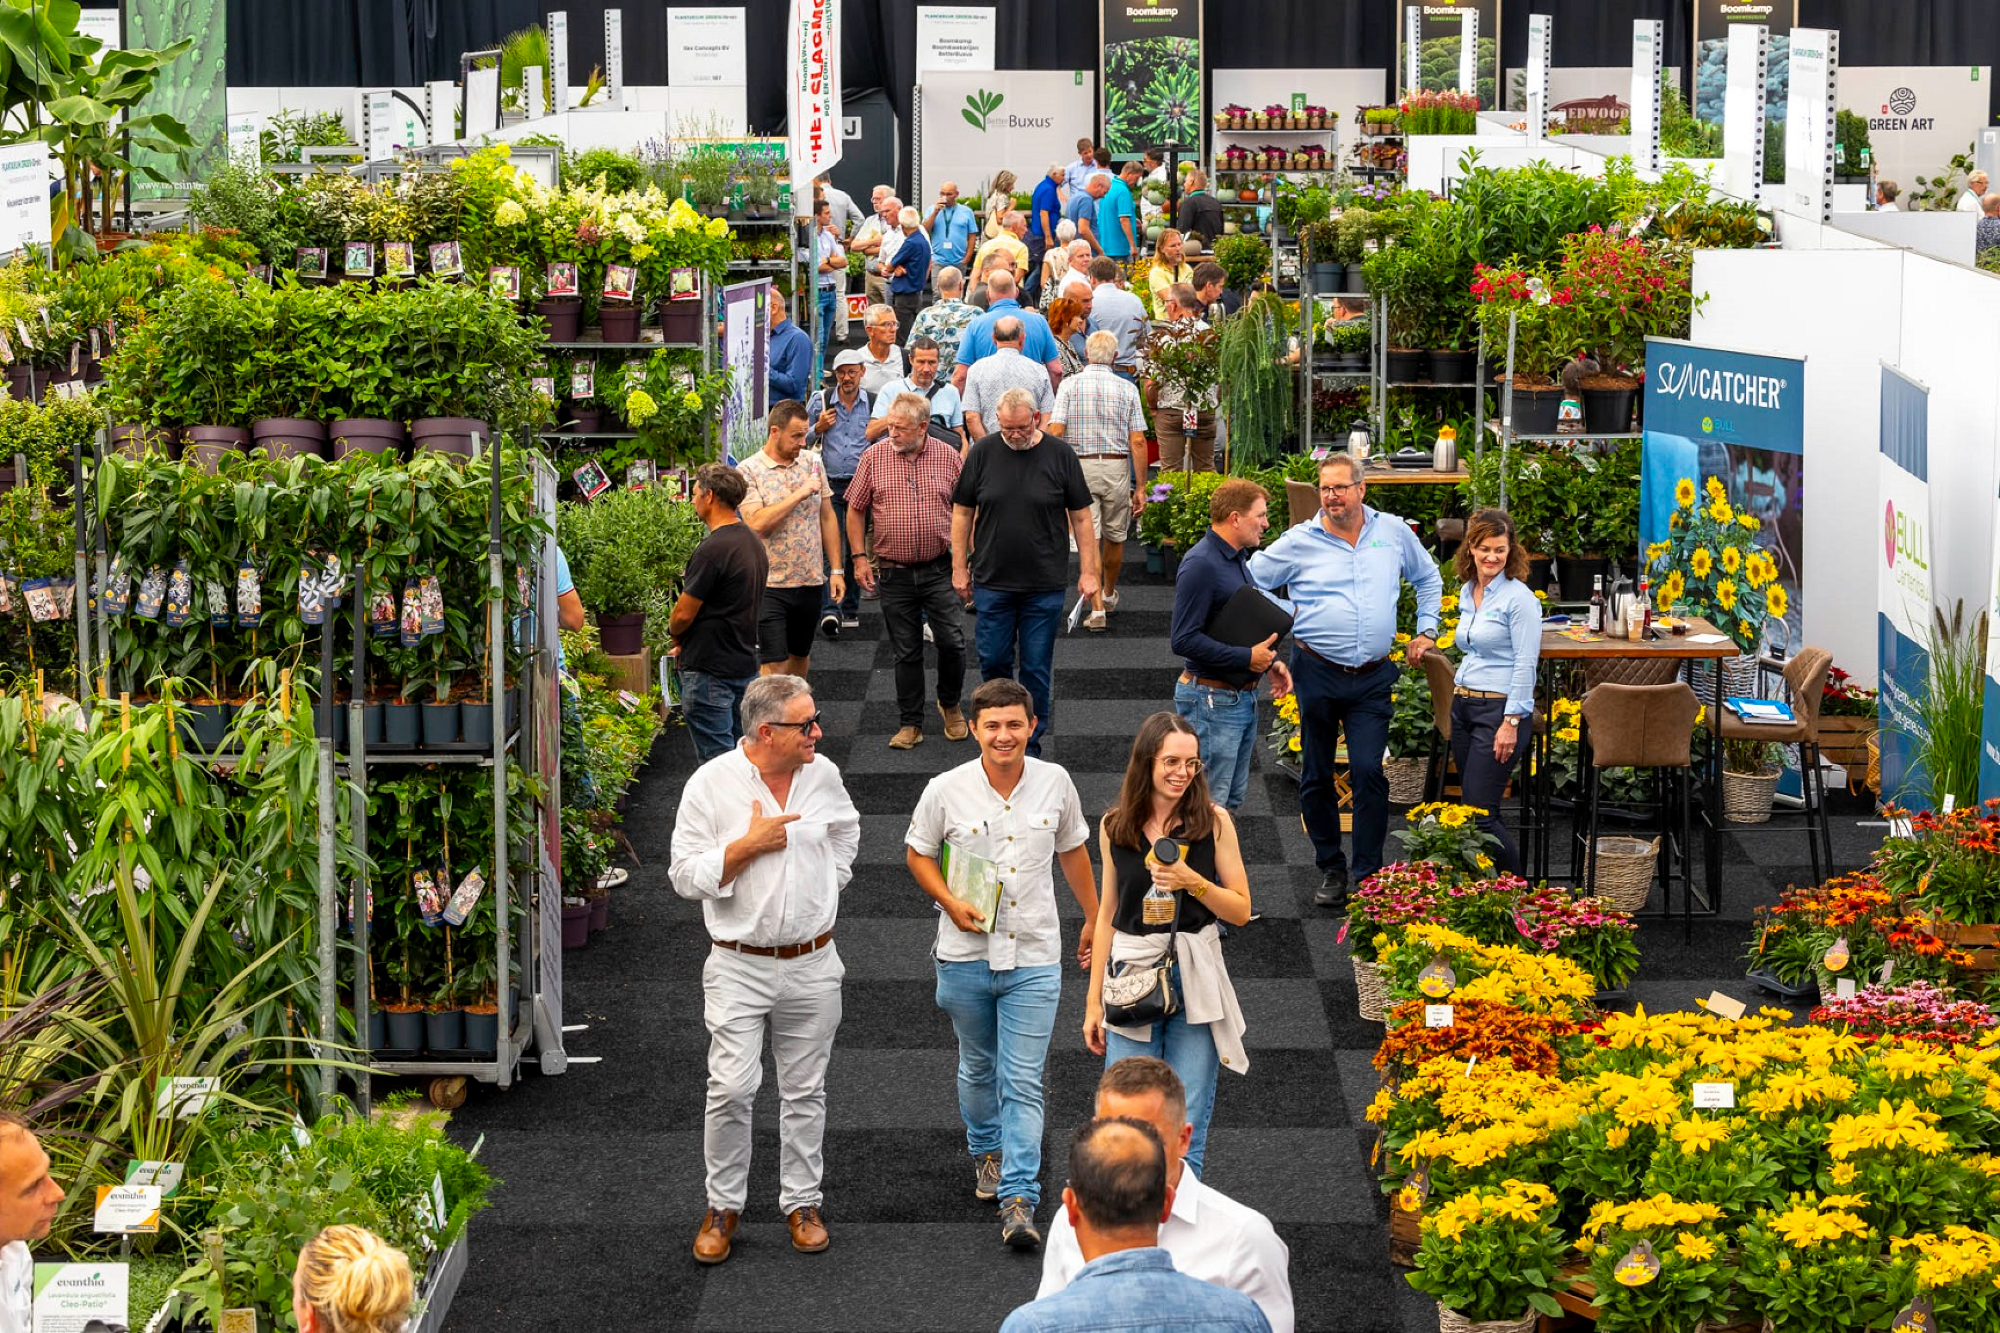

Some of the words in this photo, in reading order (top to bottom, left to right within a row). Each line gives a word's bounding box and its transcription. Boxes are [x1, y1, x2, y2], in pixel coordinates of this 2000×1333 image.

[1126, 7, 1178, 17] Boomkamp
[1720, 4, 1772, 14] Boomkamp
[844, 120, 857, 137] J
[1869, 118, 1907, 131] GREEN
[1910, 118, 1935, 131] ART
[1896, 510, 1928, 571] BULL
[57, 1277, 105, 1287] evanthia
